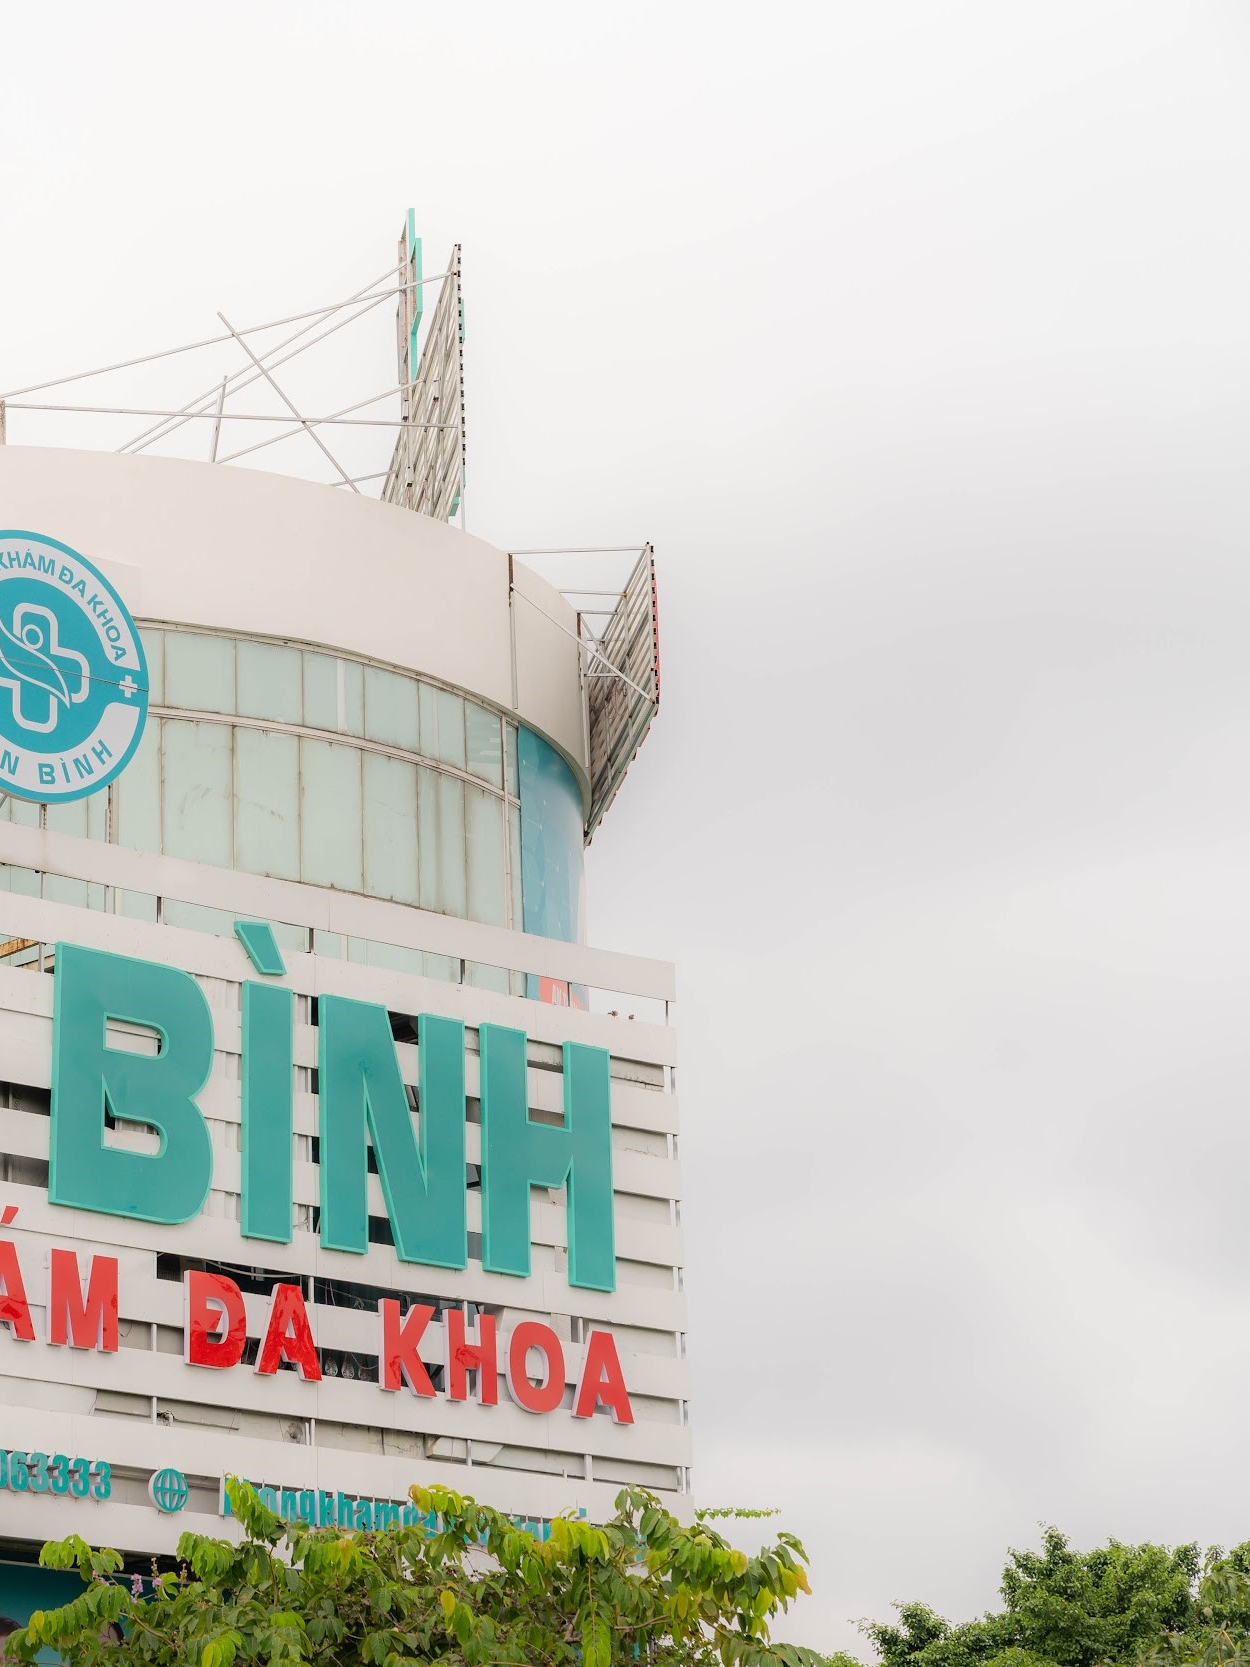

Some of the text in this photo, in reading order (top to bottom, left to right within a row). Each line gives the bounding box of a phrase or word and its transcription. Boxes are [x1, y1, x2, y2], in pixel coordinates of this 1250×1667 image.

[58, 565, 87, 599] ĐA
[86, 592, 127, 662] KHOA
[37, 739, 113, 785] BÌNH
[49, 920, 616, 1292] BÌNH
[183, 1269, 322, 1382] ĐA
[377, 1297, 634, 1425] KHOA
